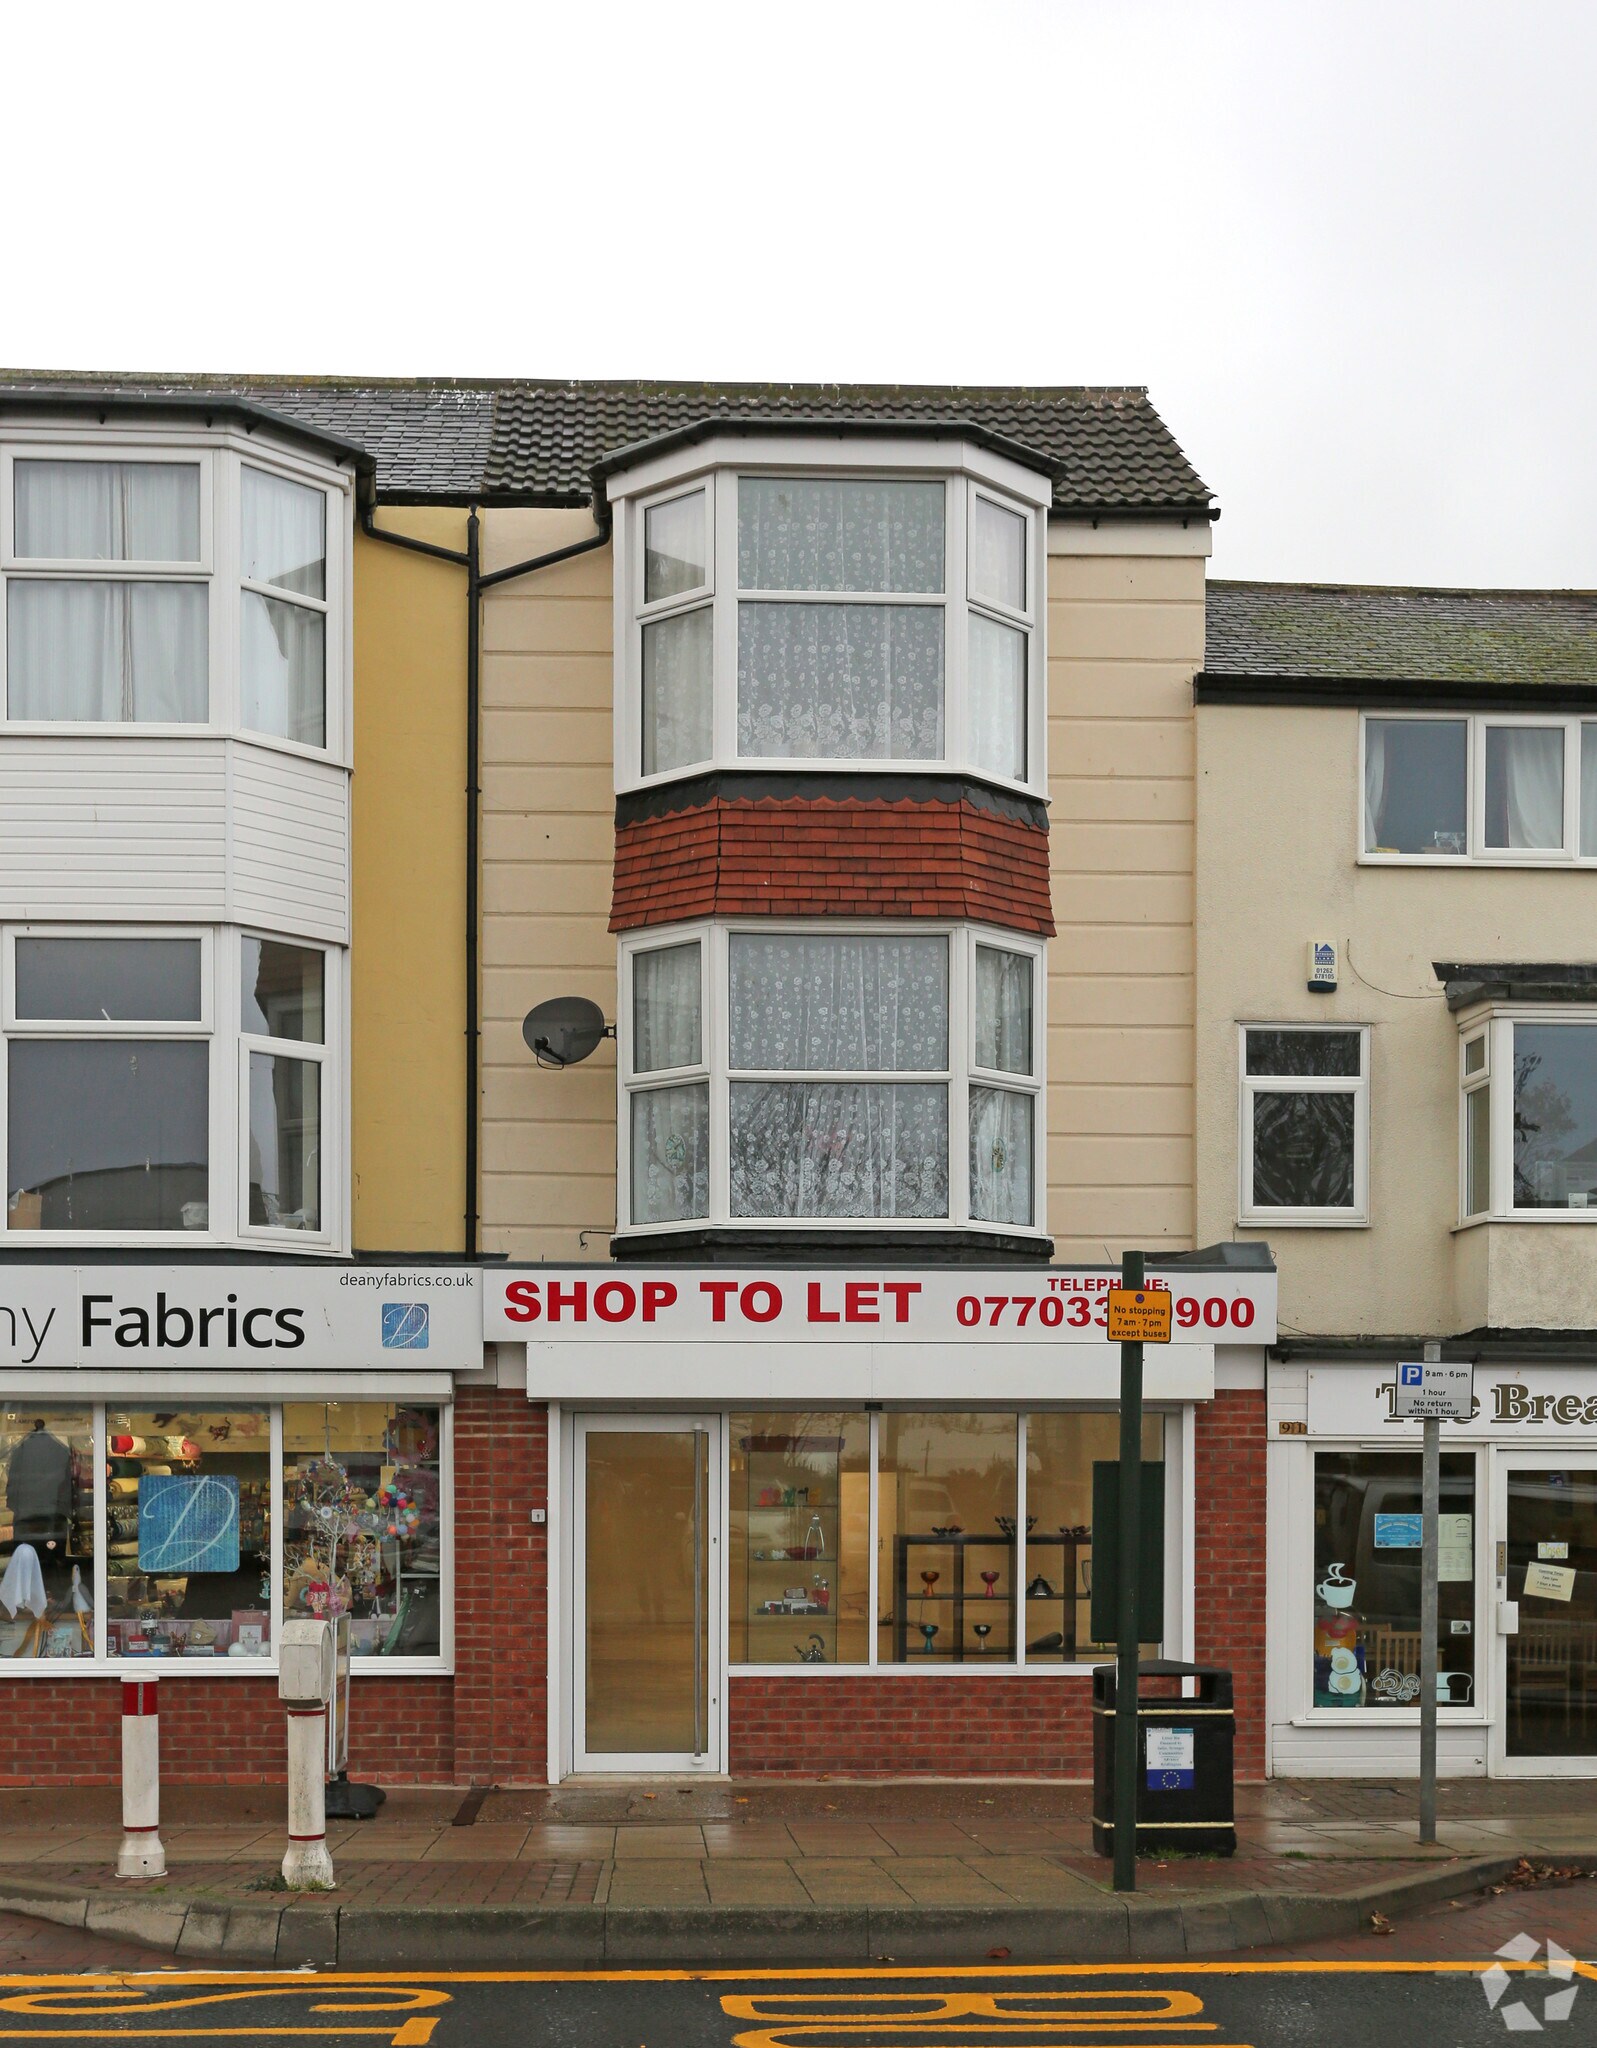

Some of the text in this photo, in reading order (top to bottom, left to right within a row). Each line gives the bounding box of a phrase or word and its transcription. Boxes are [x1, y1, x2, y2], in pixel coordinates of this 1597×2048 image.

[340, 1272, 474, 1290] deanyfabrics.co.uk
[1047, 1278, 1169, 1291] TELEPHNE:
[505, 1281, 922, 1323] SHOP TO LET
[957, 1296, 1255, 1328] 077033900
[1114, 1305, 1166, 1316] No stopping
[82, 1292, 304, 1348] Fabrics
[1111, 1329, 1167, 1338] except buses
[1406, 1367, 1420, 1384] P
[1413, 1399, 1425, 1407] No
[1408, 1407, 1433, 1415] within
[1282, 1422, 1303, 1433] 91
